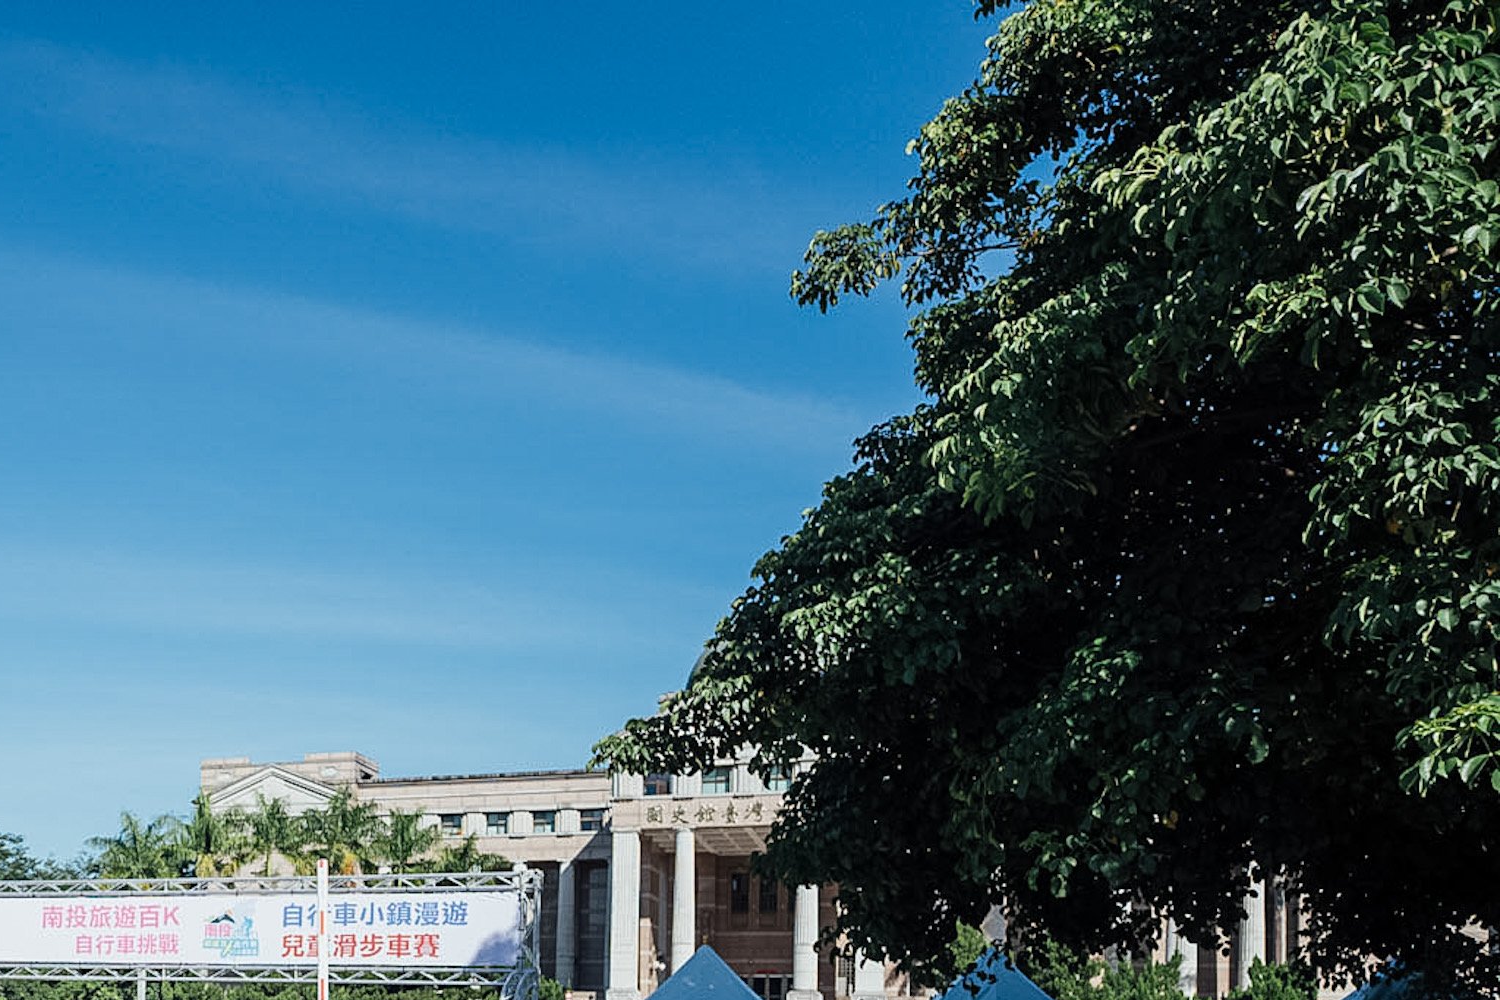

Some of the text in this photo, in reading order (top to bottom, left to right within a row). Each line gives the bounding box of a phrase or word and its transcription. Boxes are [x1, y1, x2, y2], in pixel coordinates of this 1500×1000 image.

[647, 800, 786, 825] 國史館臺灣
[42, 905, 181, 929] 南投旅遊百K
[75, 934, 180, 955] 自行車挑戰
